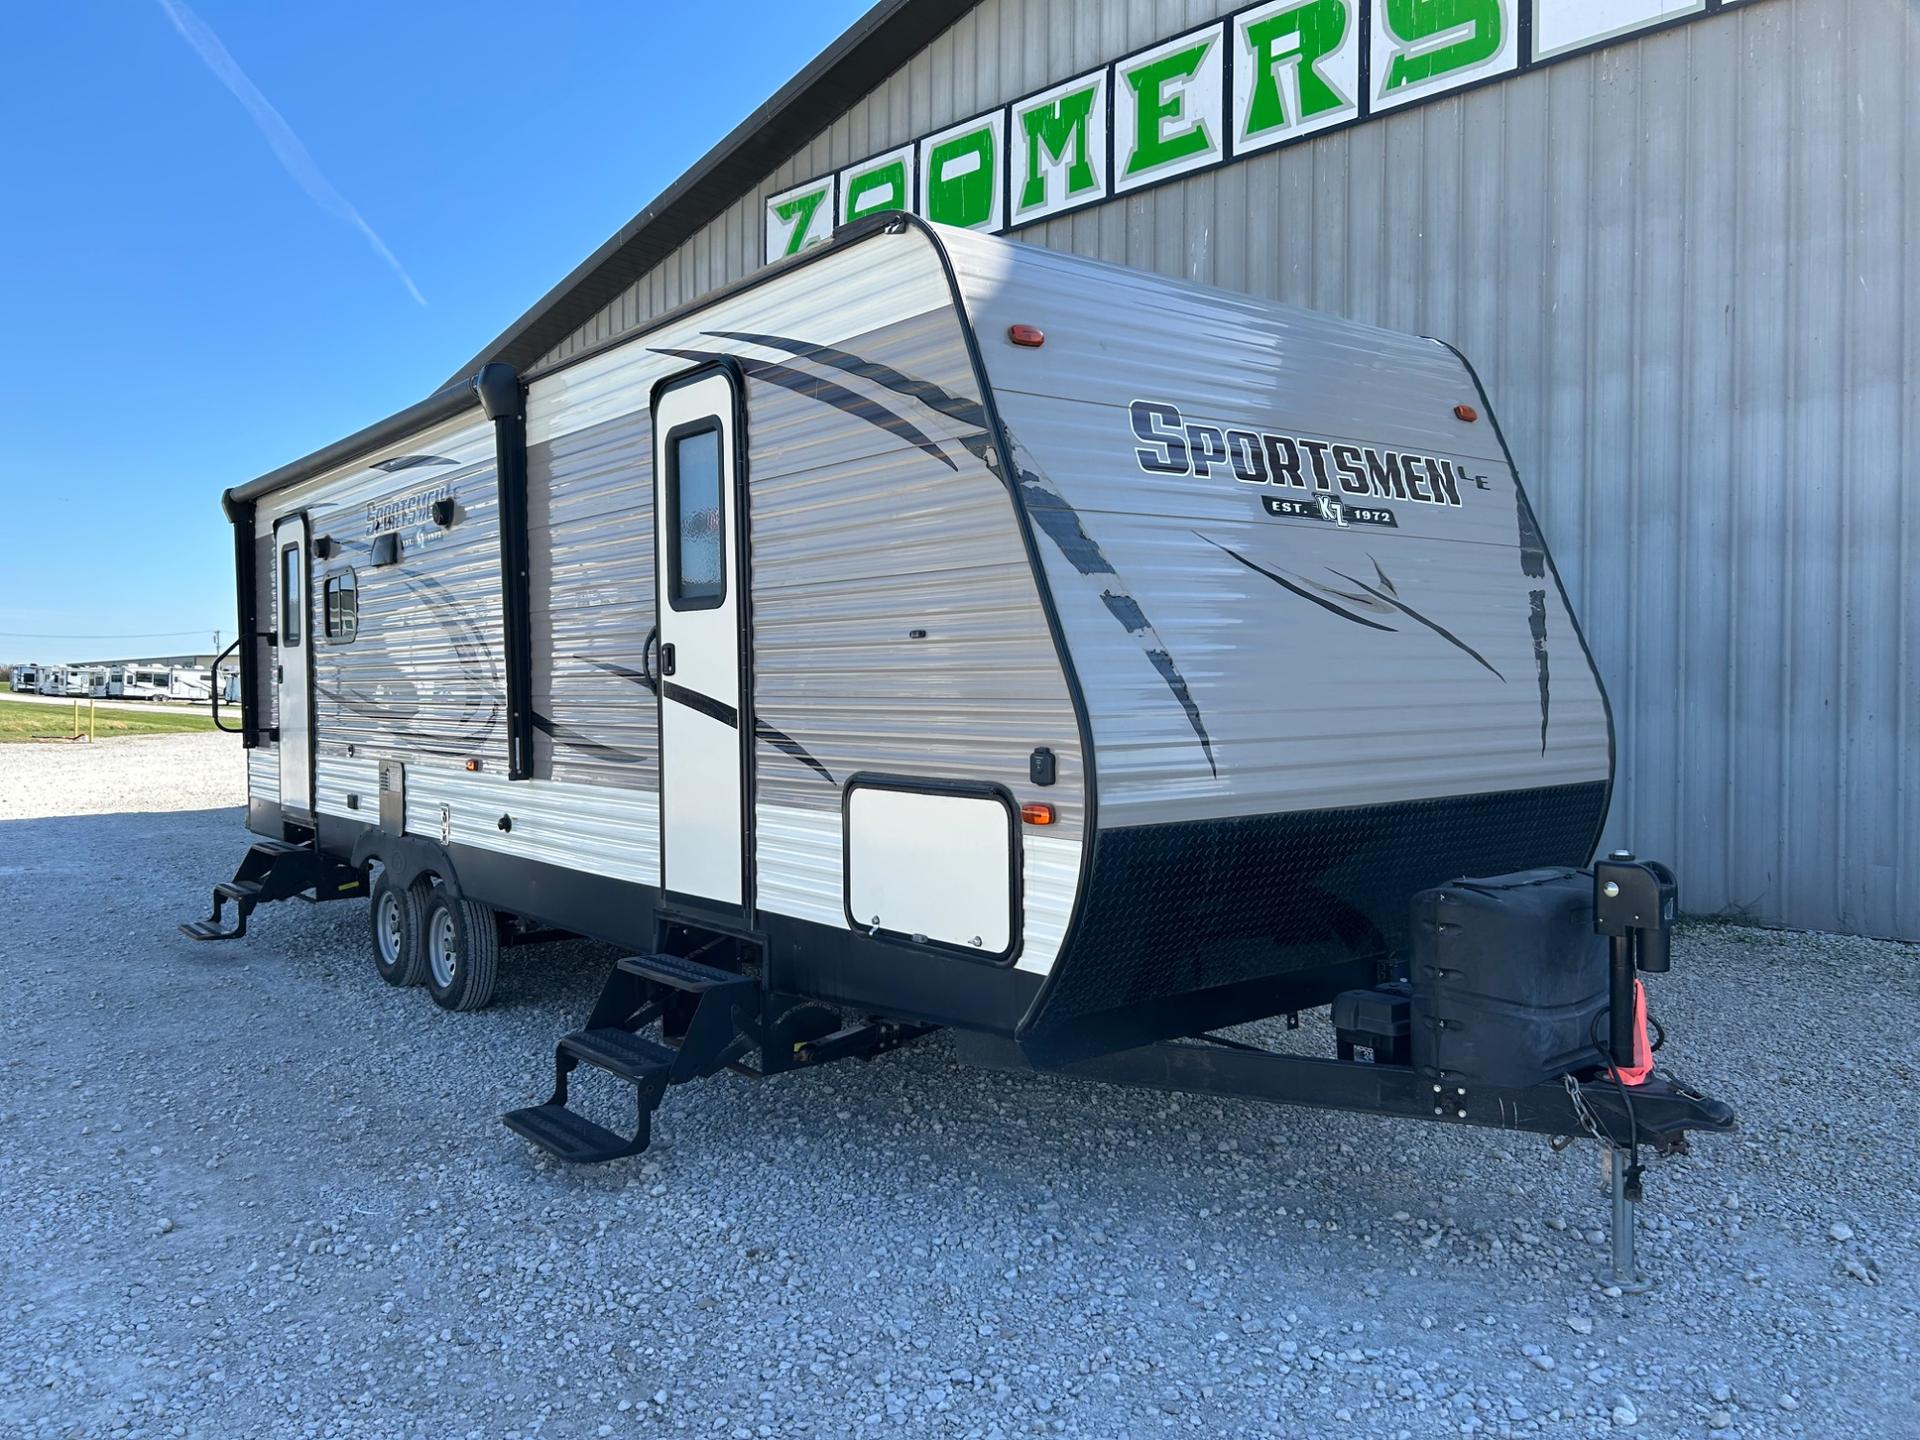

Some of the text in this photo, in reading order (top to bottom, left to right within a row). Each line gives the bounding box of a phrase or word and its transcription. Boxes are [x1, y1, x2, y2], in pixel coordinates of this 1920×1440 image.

[1128, 399, 1463, 507] SPORTSMEN
[1271, 500, 1309, 515] EST.
[1353, 509, 1392, 523] 1972
